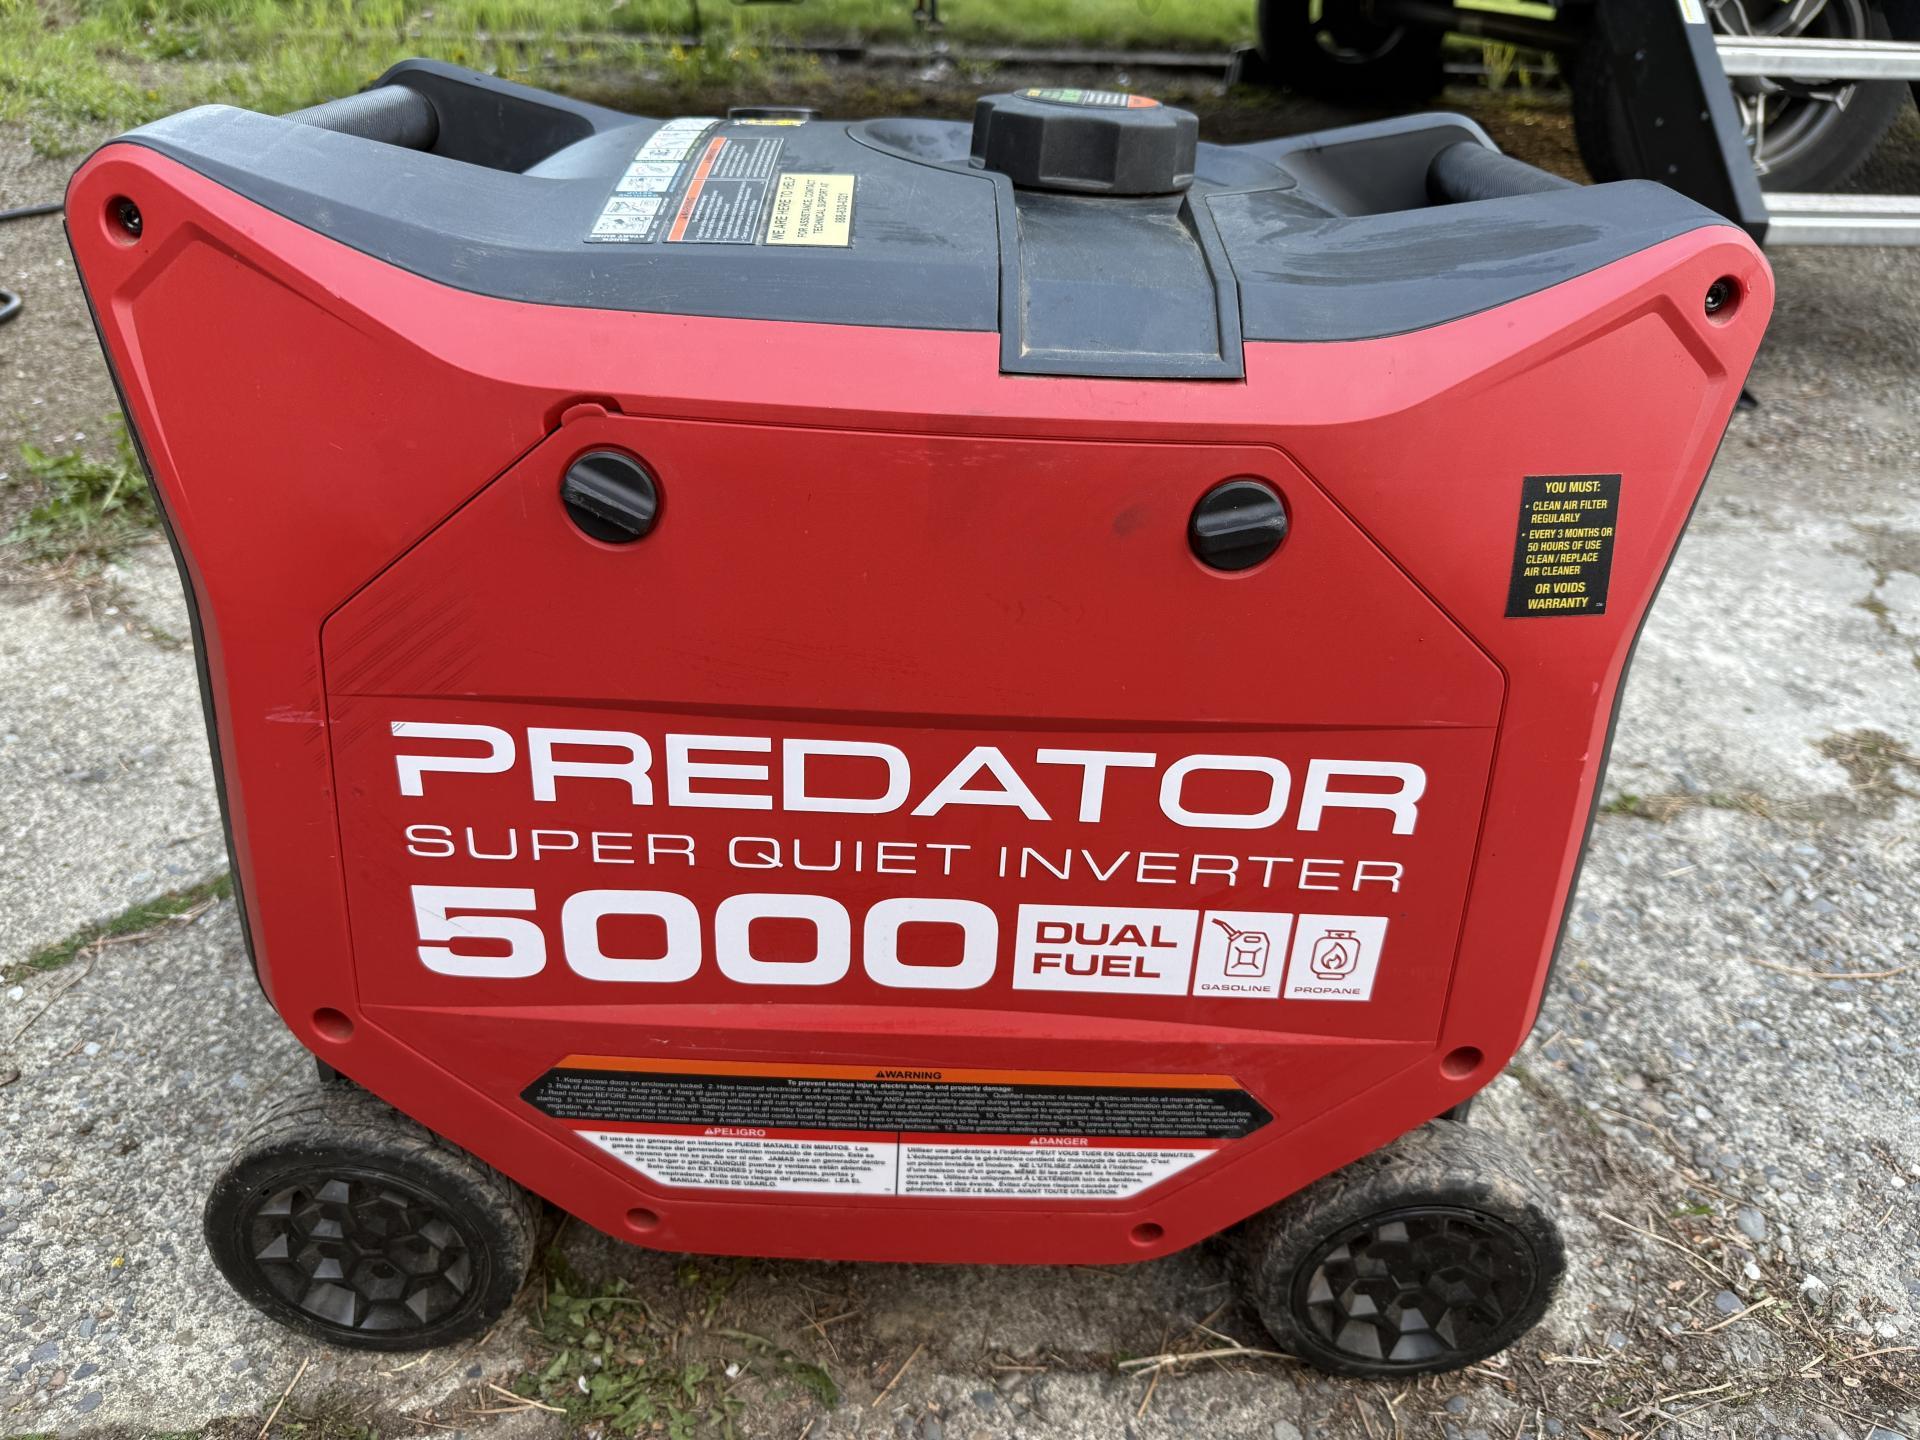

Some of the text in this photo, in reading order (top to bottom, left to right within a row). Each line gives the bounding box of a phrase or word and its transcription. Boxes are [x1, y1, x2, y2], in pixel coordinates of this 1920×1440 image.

[783, 177, 796, 189] HELP
[777, 200, 791, 214] HERE
[798, 180, 815, 237] FOR ASSISTANCE CONTACT
[774, 216, 788, 228] ARE
[813, 208, 826, 234] TECHNICAL
[771, 230, 785, 240] WE
[1545, 481, 1601, 493] YOU MUST:
[1532, 500, 1608, 511] CLEAN AIR FILTER
[1531, 513, 1581, 523] REGULARLY
[1529, 527, 1613, 539] EVERY 3 MONTHS OR
[1527, 540, 1602, 552] 50 HOURS OF USE
[1524, 565, 1581, 576] AIR CLEANER
[1535, 582, 1586, 594] OR VOIDS
[1528, 597, 1589, 609] WARRANTY
[391, 721, 1426, 835] PREDATOR
[405, 824, 1404, 894] SUPER QUIET INVERTER
[410, 884, 999, 990] 5000
[1035, 922, 1178, 948] DUAL
[1032, 954, 1160, 979] FUEL
[1201, 983, 1271, 992] GASOLINE
[1294, 986, 1361, 995] PROPANE
[886, 1071, 942, 1080] WARNING
[712, 1128, 766, 1137] PELIGRO
[1038, 1137, 1088, 1145] DANGER
